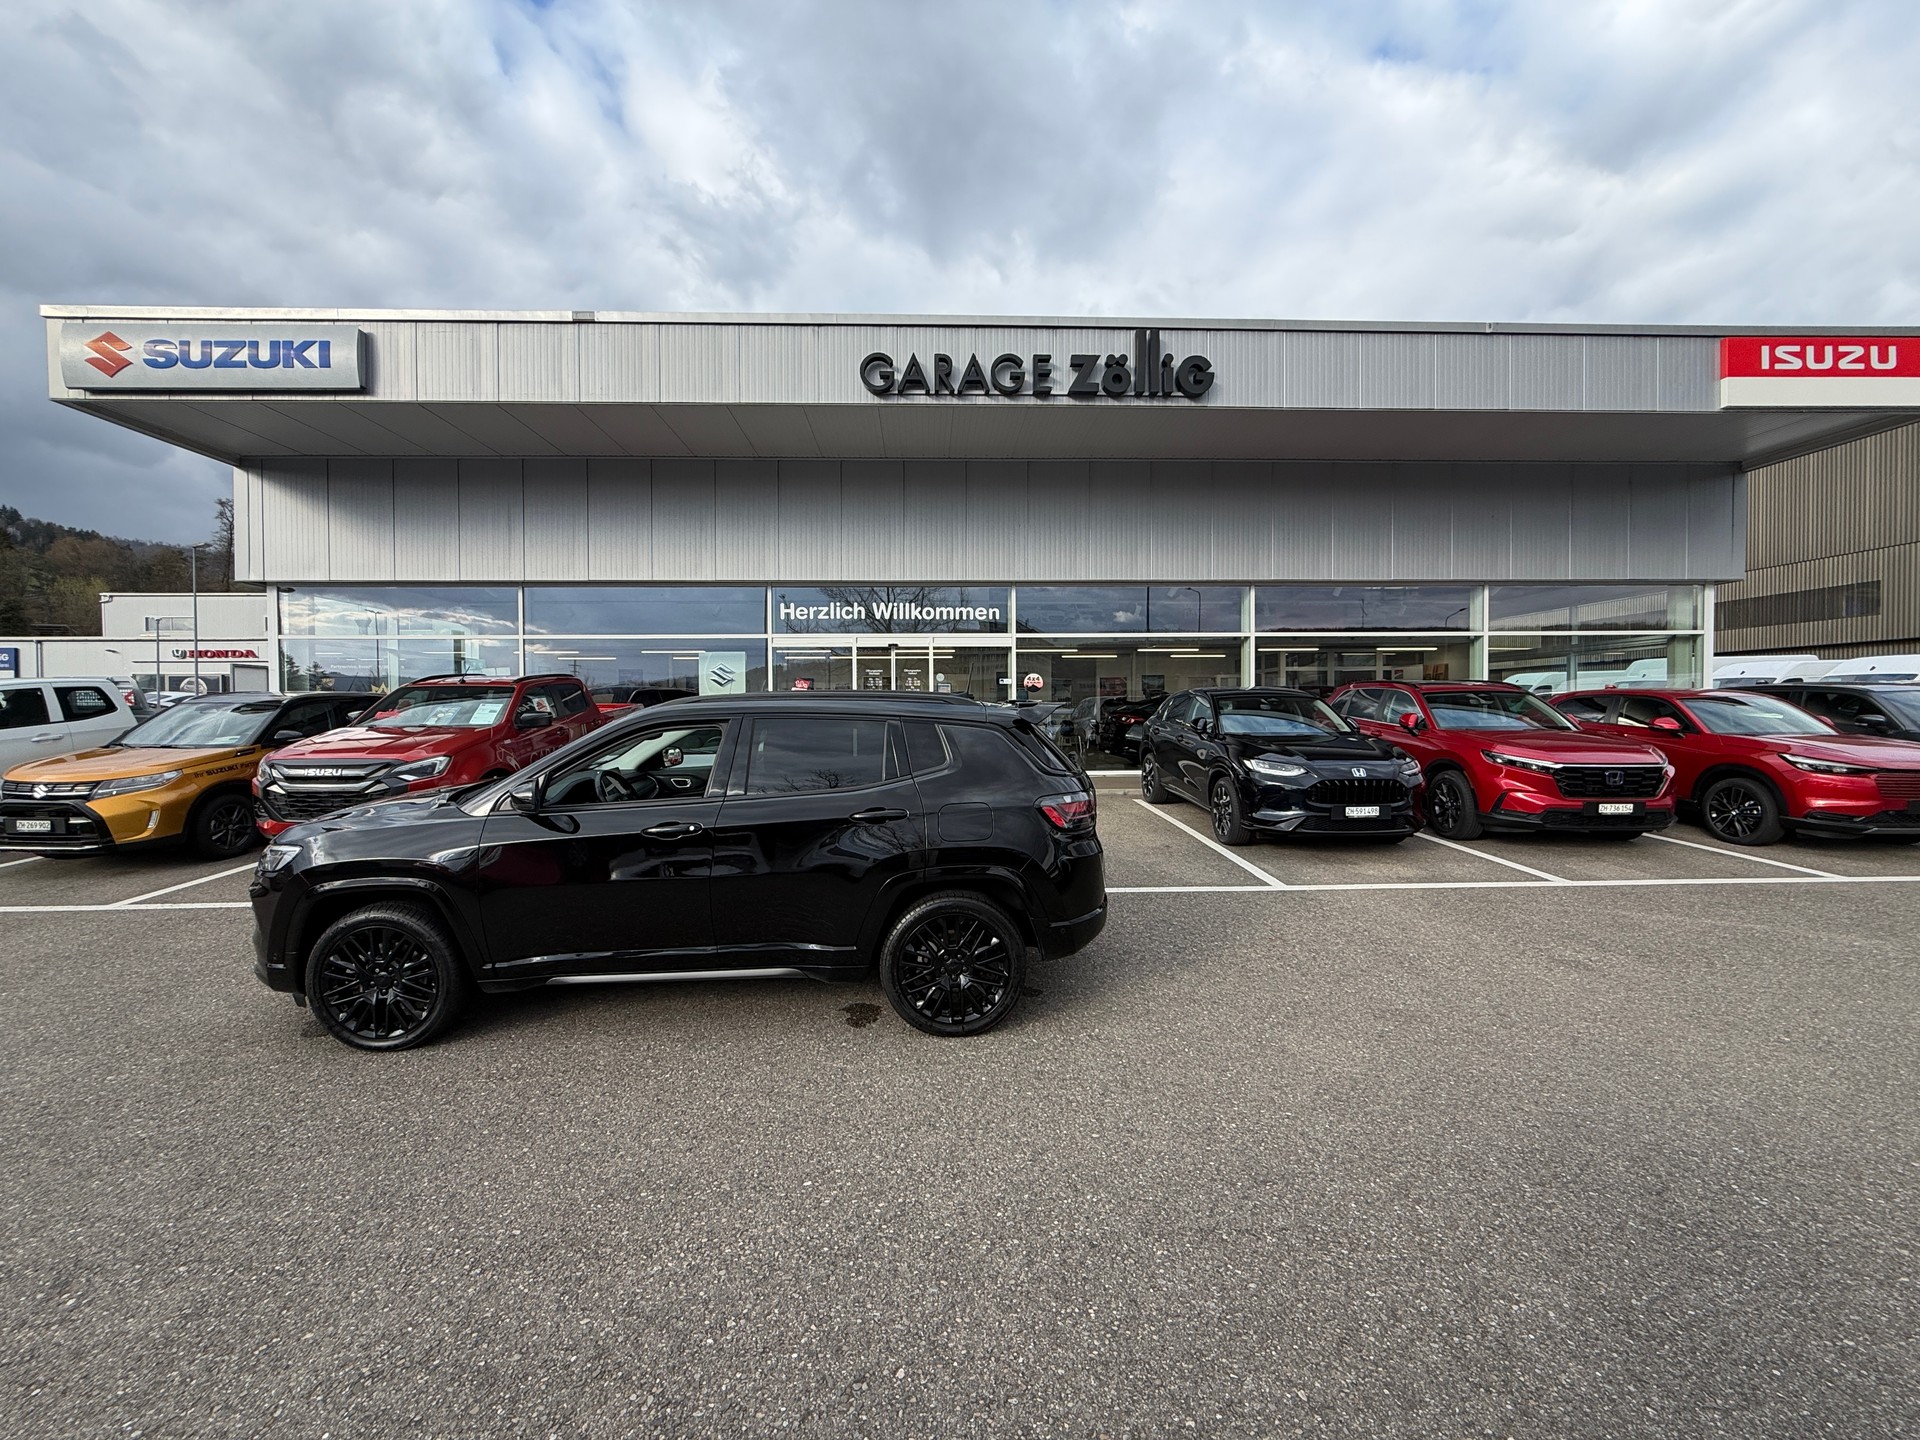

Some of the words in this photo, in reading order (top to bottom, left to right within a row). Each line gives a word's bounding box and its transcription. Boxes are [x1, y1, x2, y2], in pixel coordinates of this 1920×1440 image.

[142, 338, 331, 370] SUZUKI
[1760, 345, 1897, 370] ISUZU
[859, 351, 1054, 397] GARAGE
[778, 602, 866, 620] Herzlich
[872, 602, 1000, 621] Willkommen
[187, 649, 259, 659] HONDA
[205, 764, 239, 776] SUZUKI
[240, 760, 257, 769] Partn
[304, 768, 342, 776] ISUZU
